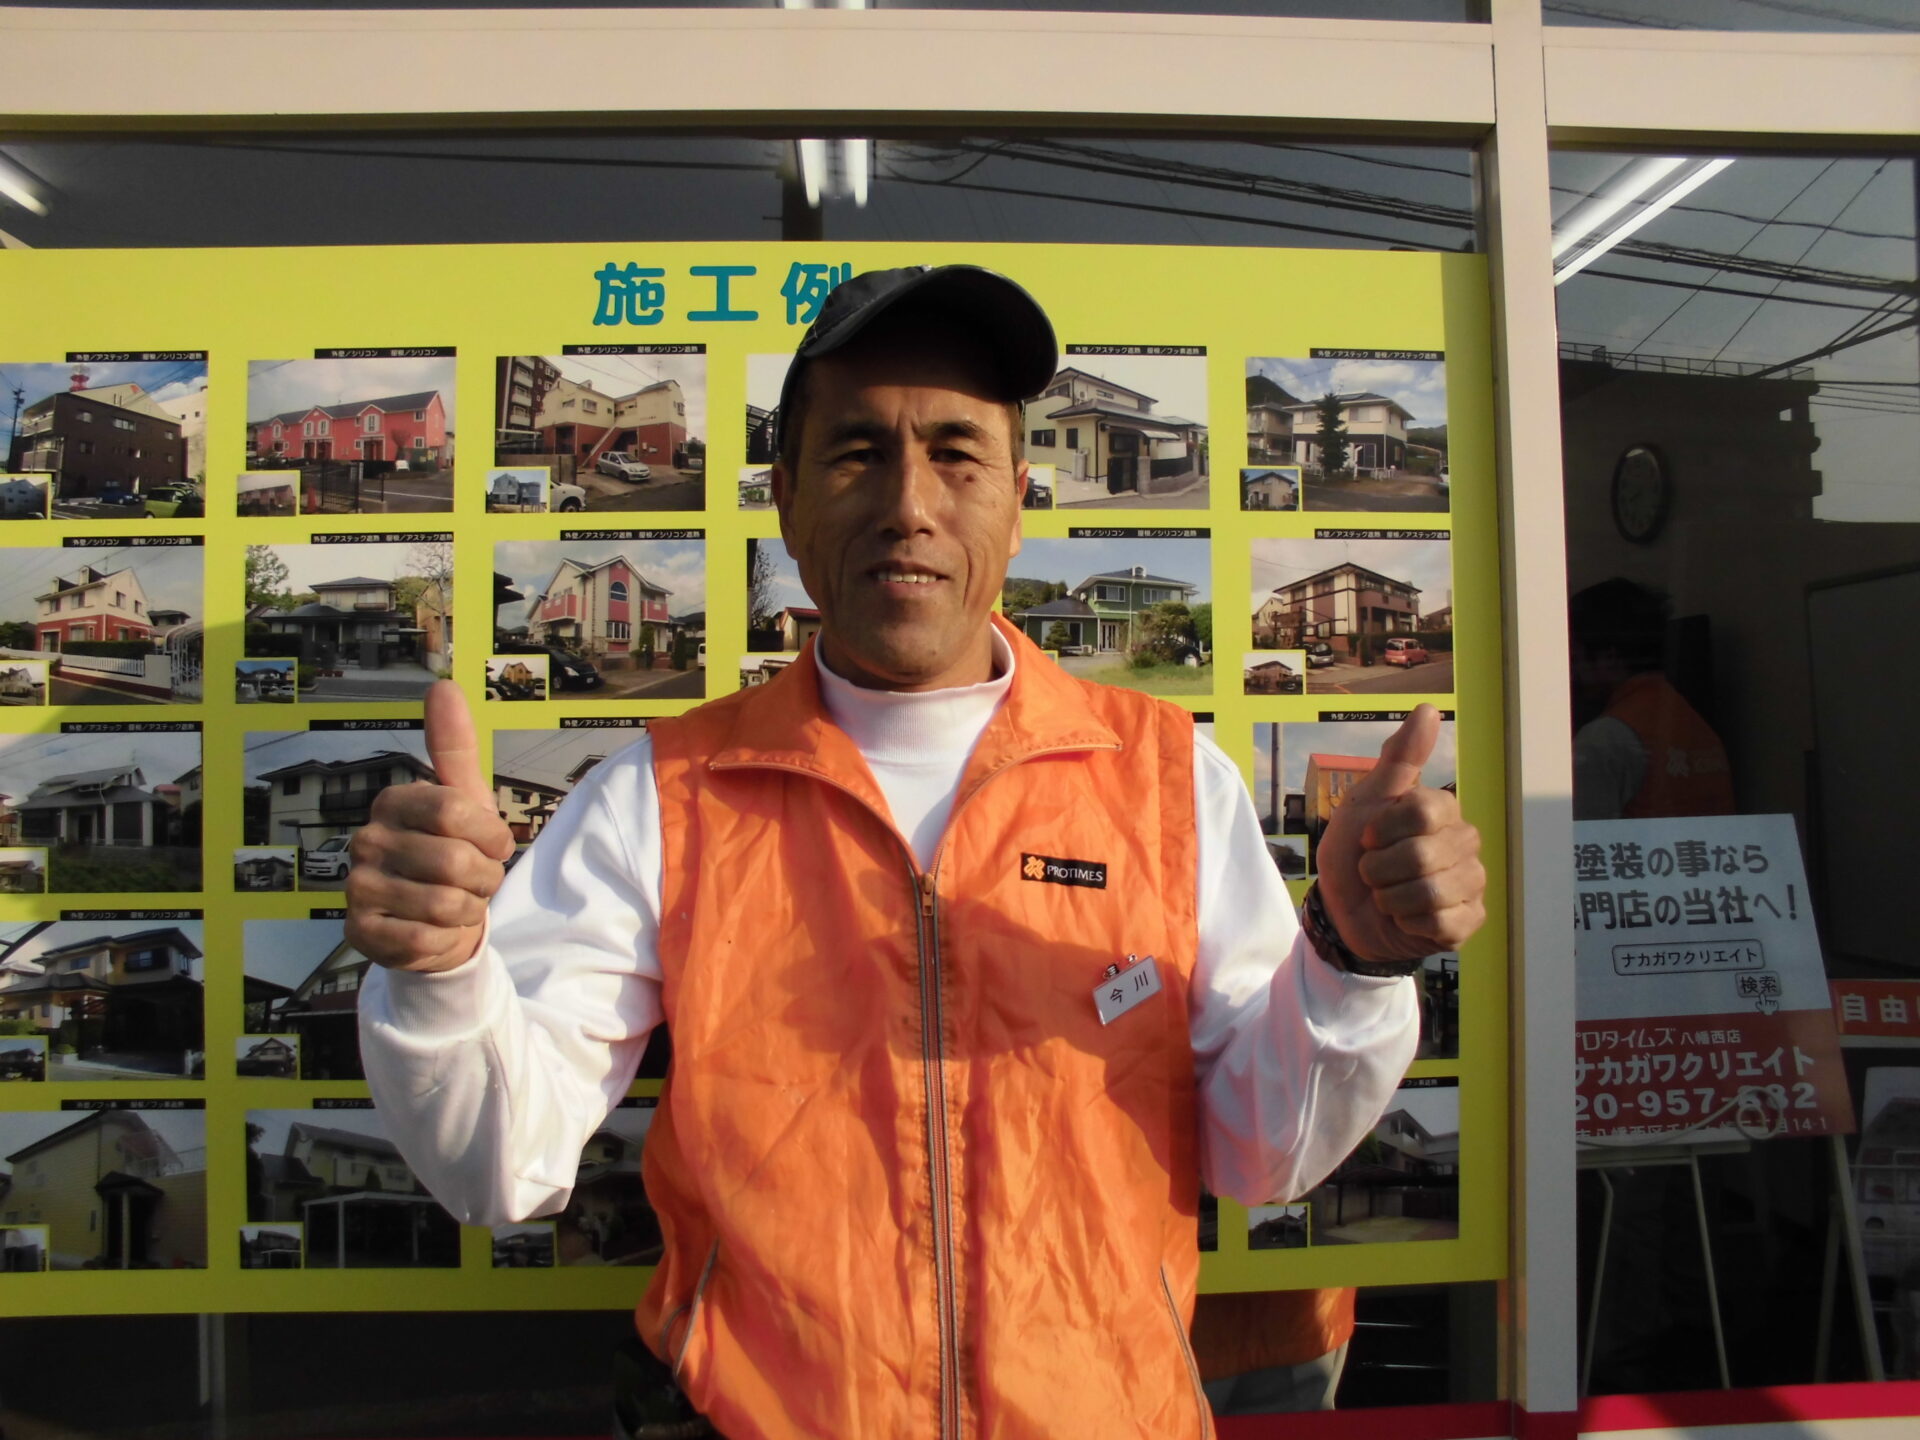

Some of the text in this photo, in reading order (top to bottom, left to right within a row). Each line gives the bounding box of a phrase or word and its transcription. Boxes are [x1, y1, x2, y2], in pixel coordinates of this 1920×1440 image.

[592, 261, 852, 326] 施工例
[1047, 864, 1104, 882] PROTIMES
[1574, 884, 1798, 930] 門店の当社へ!
[1621, 948, 1758, 968] ナカガワクリエイト
[1109, 970, 1149, 1004] 今川
[1740, 974, 1778, 994] 検索
[1575, 1027, 1742, 1051] ロタイムズ 八幡西店
[1575, 1045, 1815, 1087] ナカガワクリエイト
